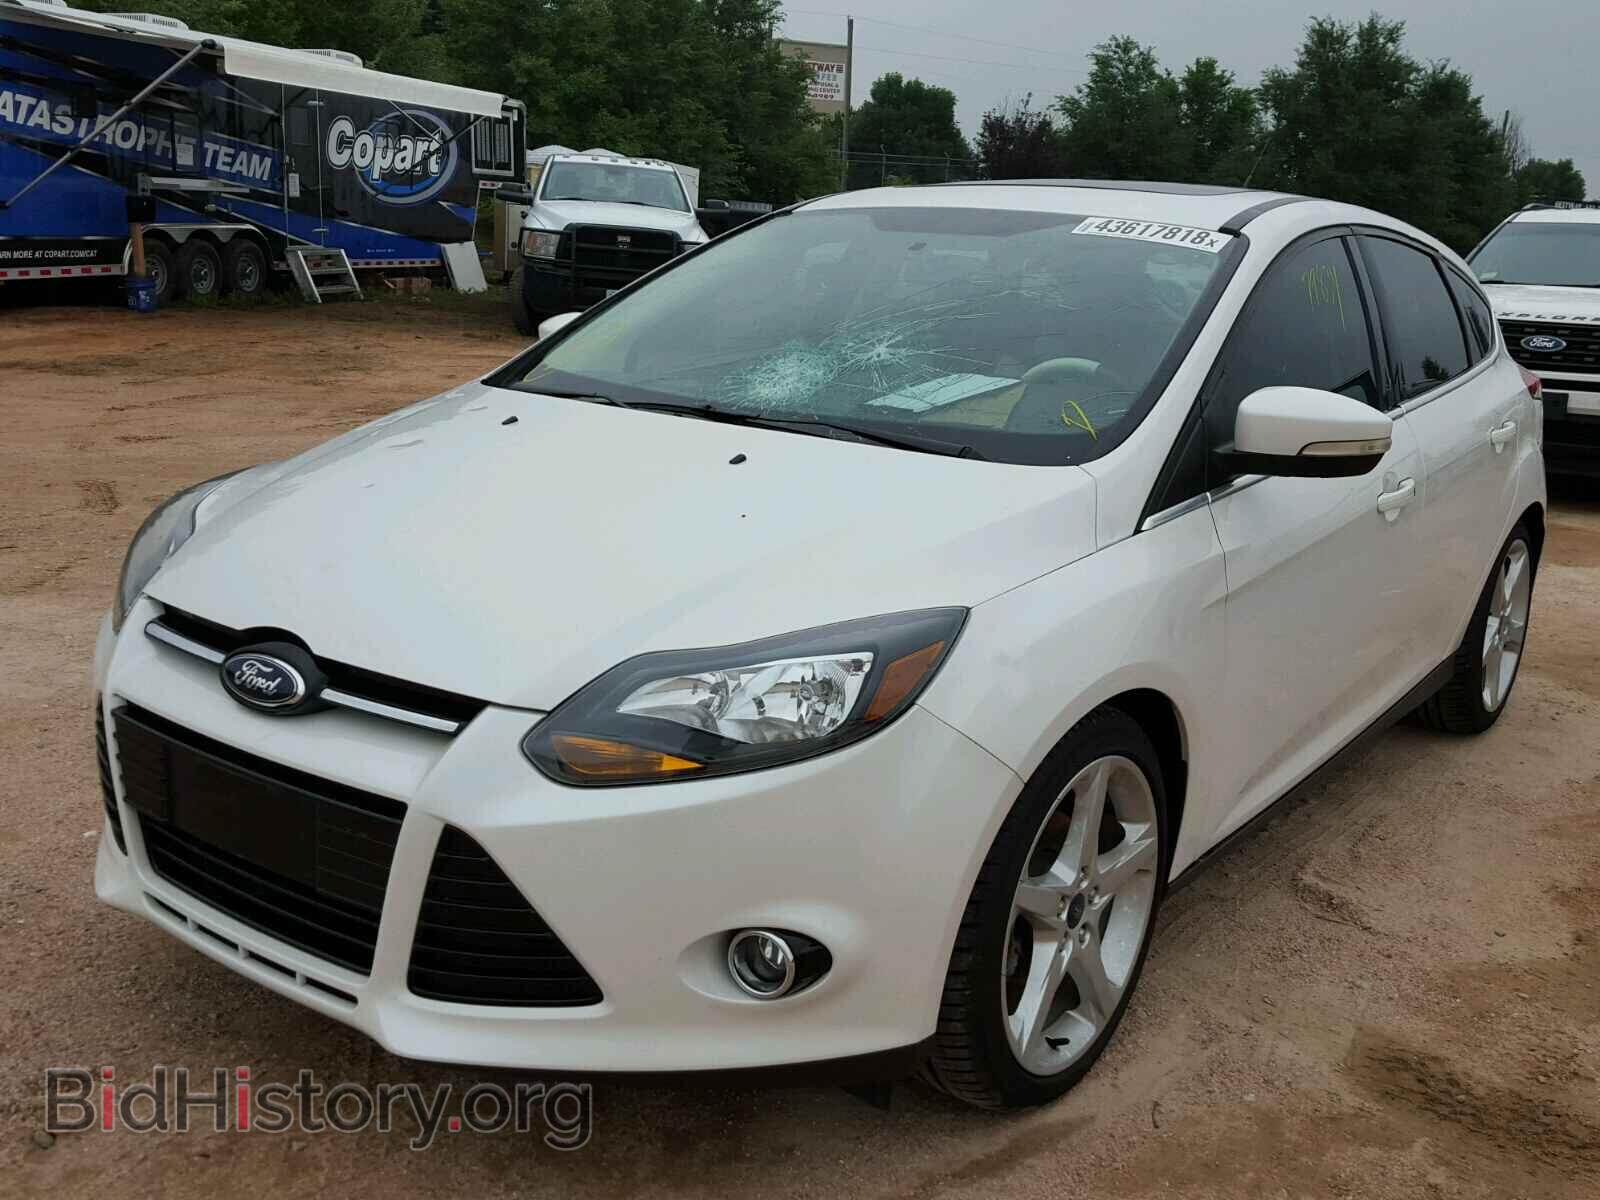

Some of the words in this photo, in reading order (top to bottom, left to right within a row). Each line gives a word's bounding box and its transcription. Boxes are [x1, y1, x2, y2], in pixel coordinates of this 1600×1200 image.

[203, 141, 272, 181] TEAM
[327, 115, 443, 182] Copart
[13, 249, 33, 259] MORE
[34, 249, 43, 258] AT
[1529, 337, 1556, 348] Ford
[234, 659, 283, 696] Ford
